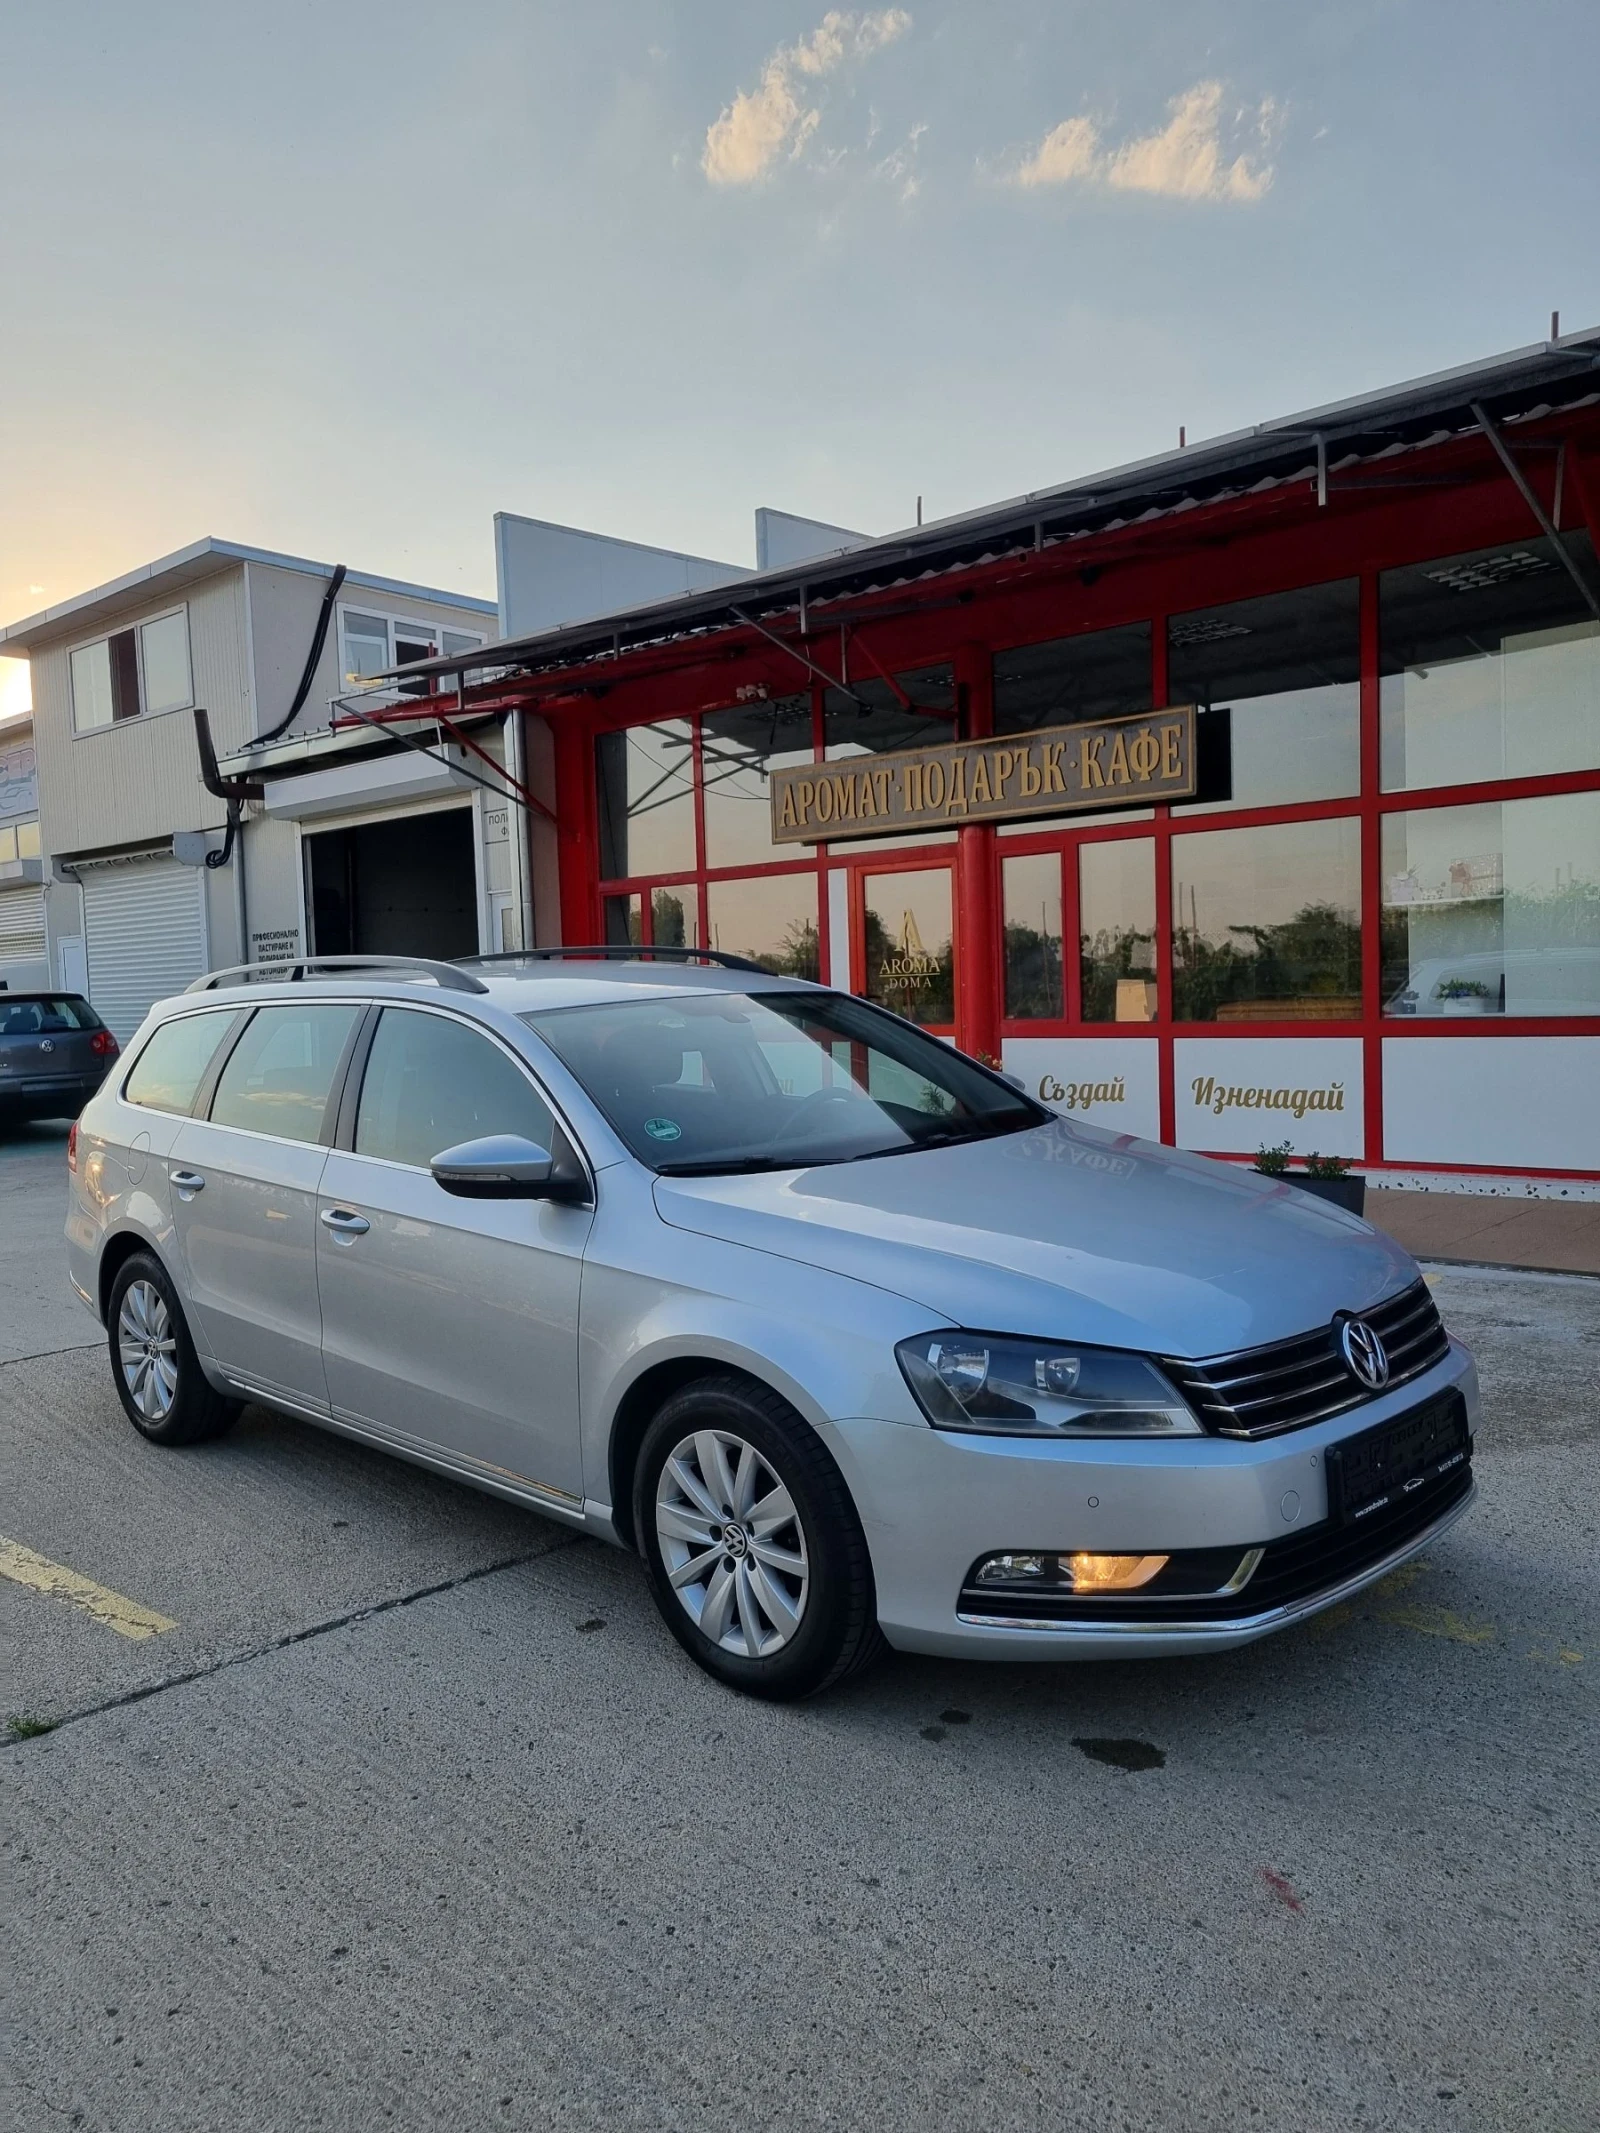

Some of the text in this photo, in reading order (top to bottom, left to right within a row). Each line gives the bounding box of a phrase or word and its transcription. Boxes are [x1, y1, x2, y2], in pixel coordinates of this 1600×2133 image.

[780, 723, 1184, 828] АРОМАТ ПОДАРЪК КАФЕ
[879, 957, 941, 975] AROMA
[888, 976, 932, 989] DOMA
[1038, 1074, 1126, 1109] Създай
[1190, 1076, 1345, 1118] Изненадай
